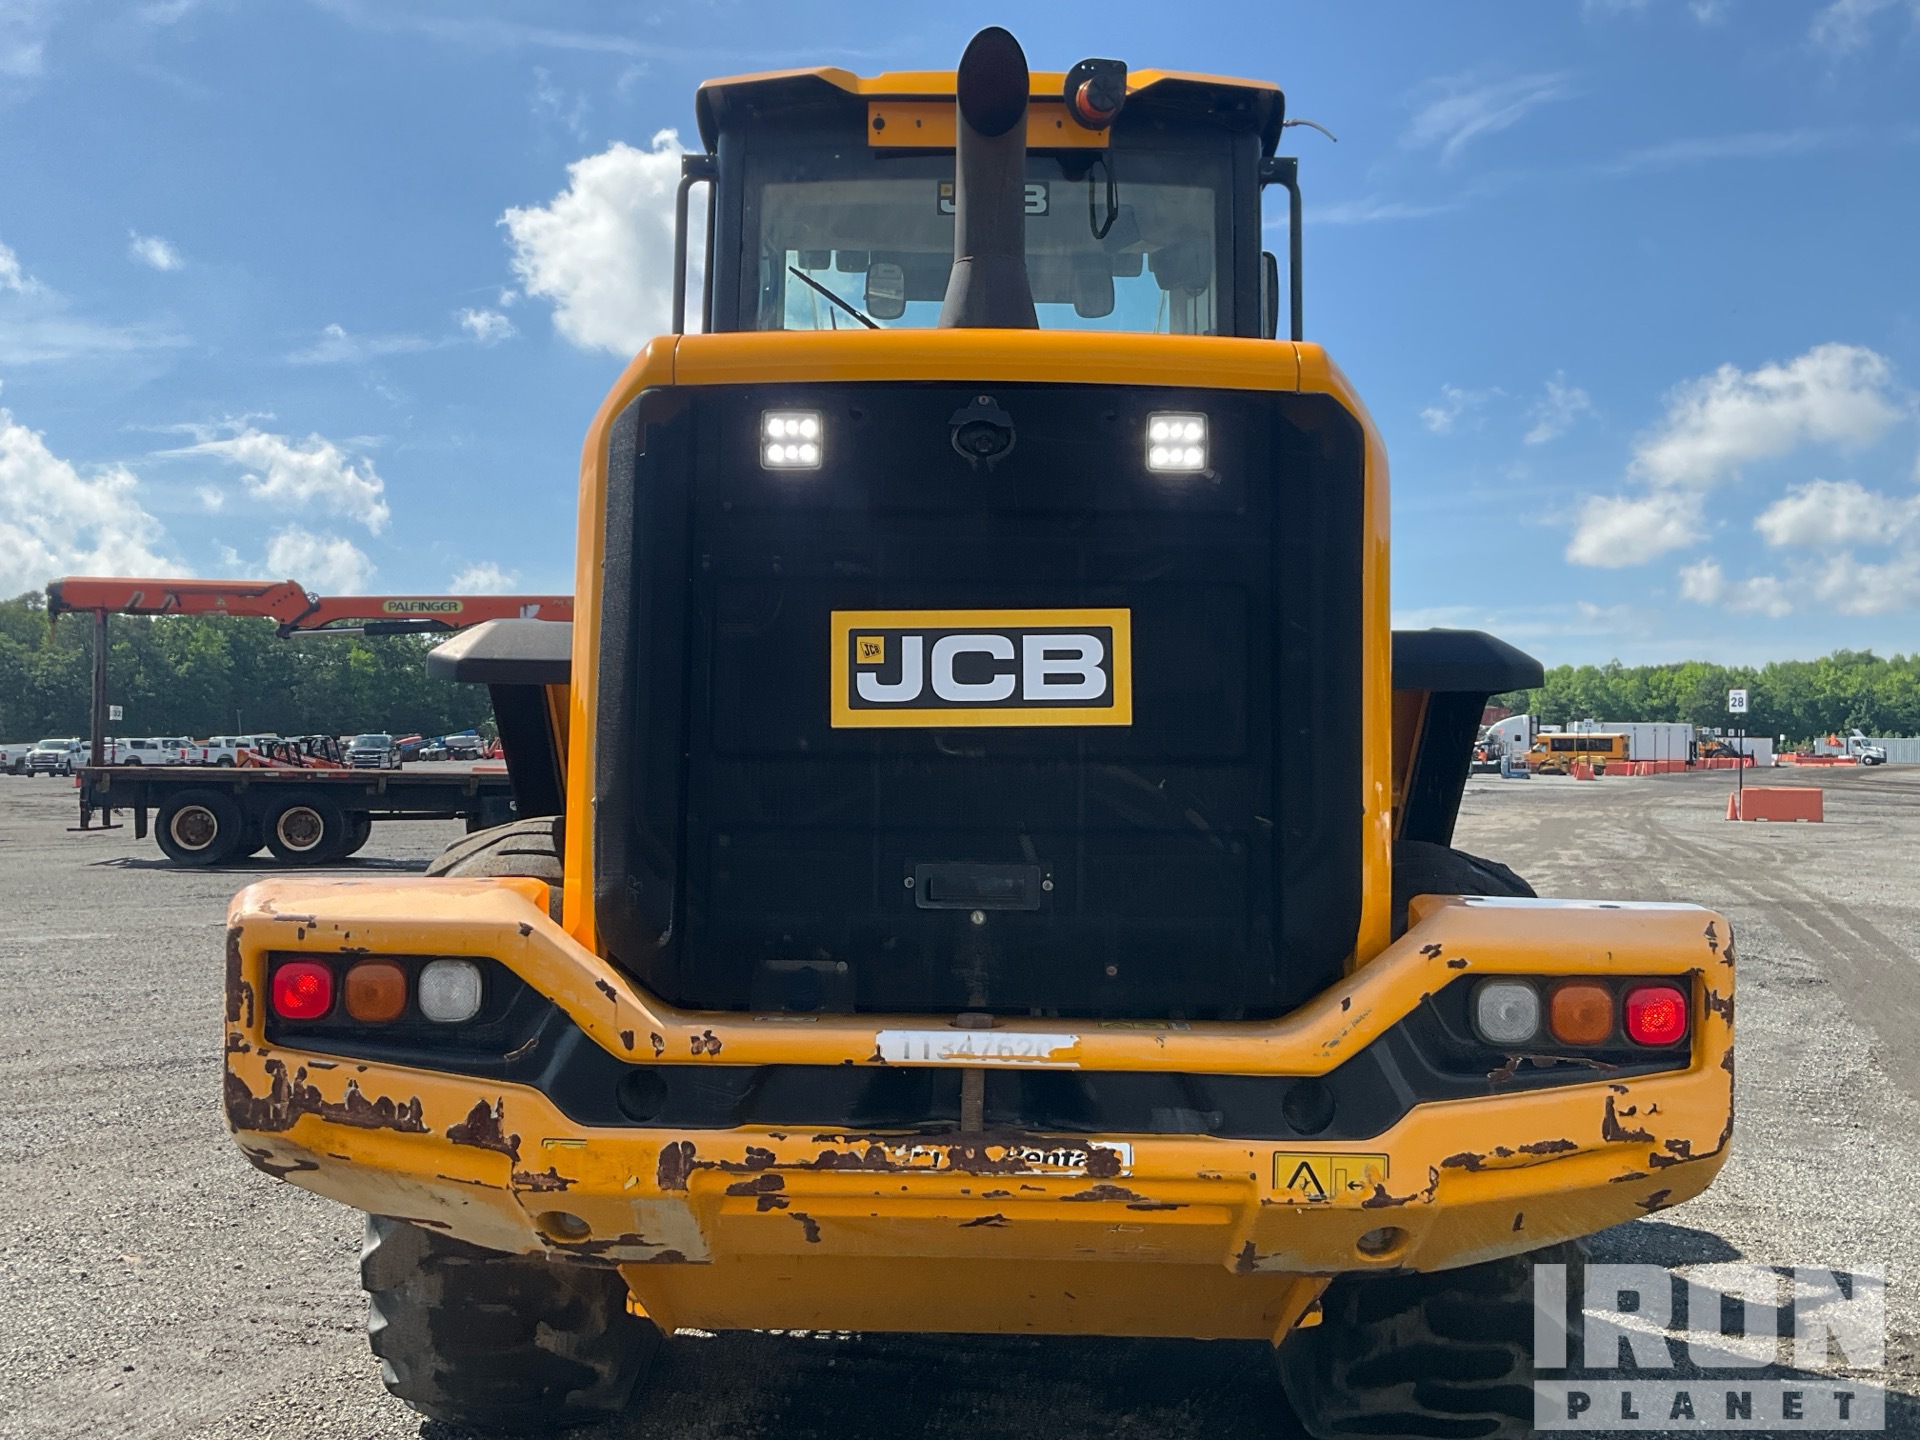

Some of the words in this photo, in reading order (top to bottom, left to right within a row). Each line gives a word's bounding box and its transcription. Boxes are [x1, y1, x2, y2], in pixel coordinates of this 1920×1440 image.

[388, 601, 457, 611] PALFINGER
[864, 643, 880, 657] JCB
[856, 634, 1107, 703] JCB
[1731, 696, 1743, 707] 28
